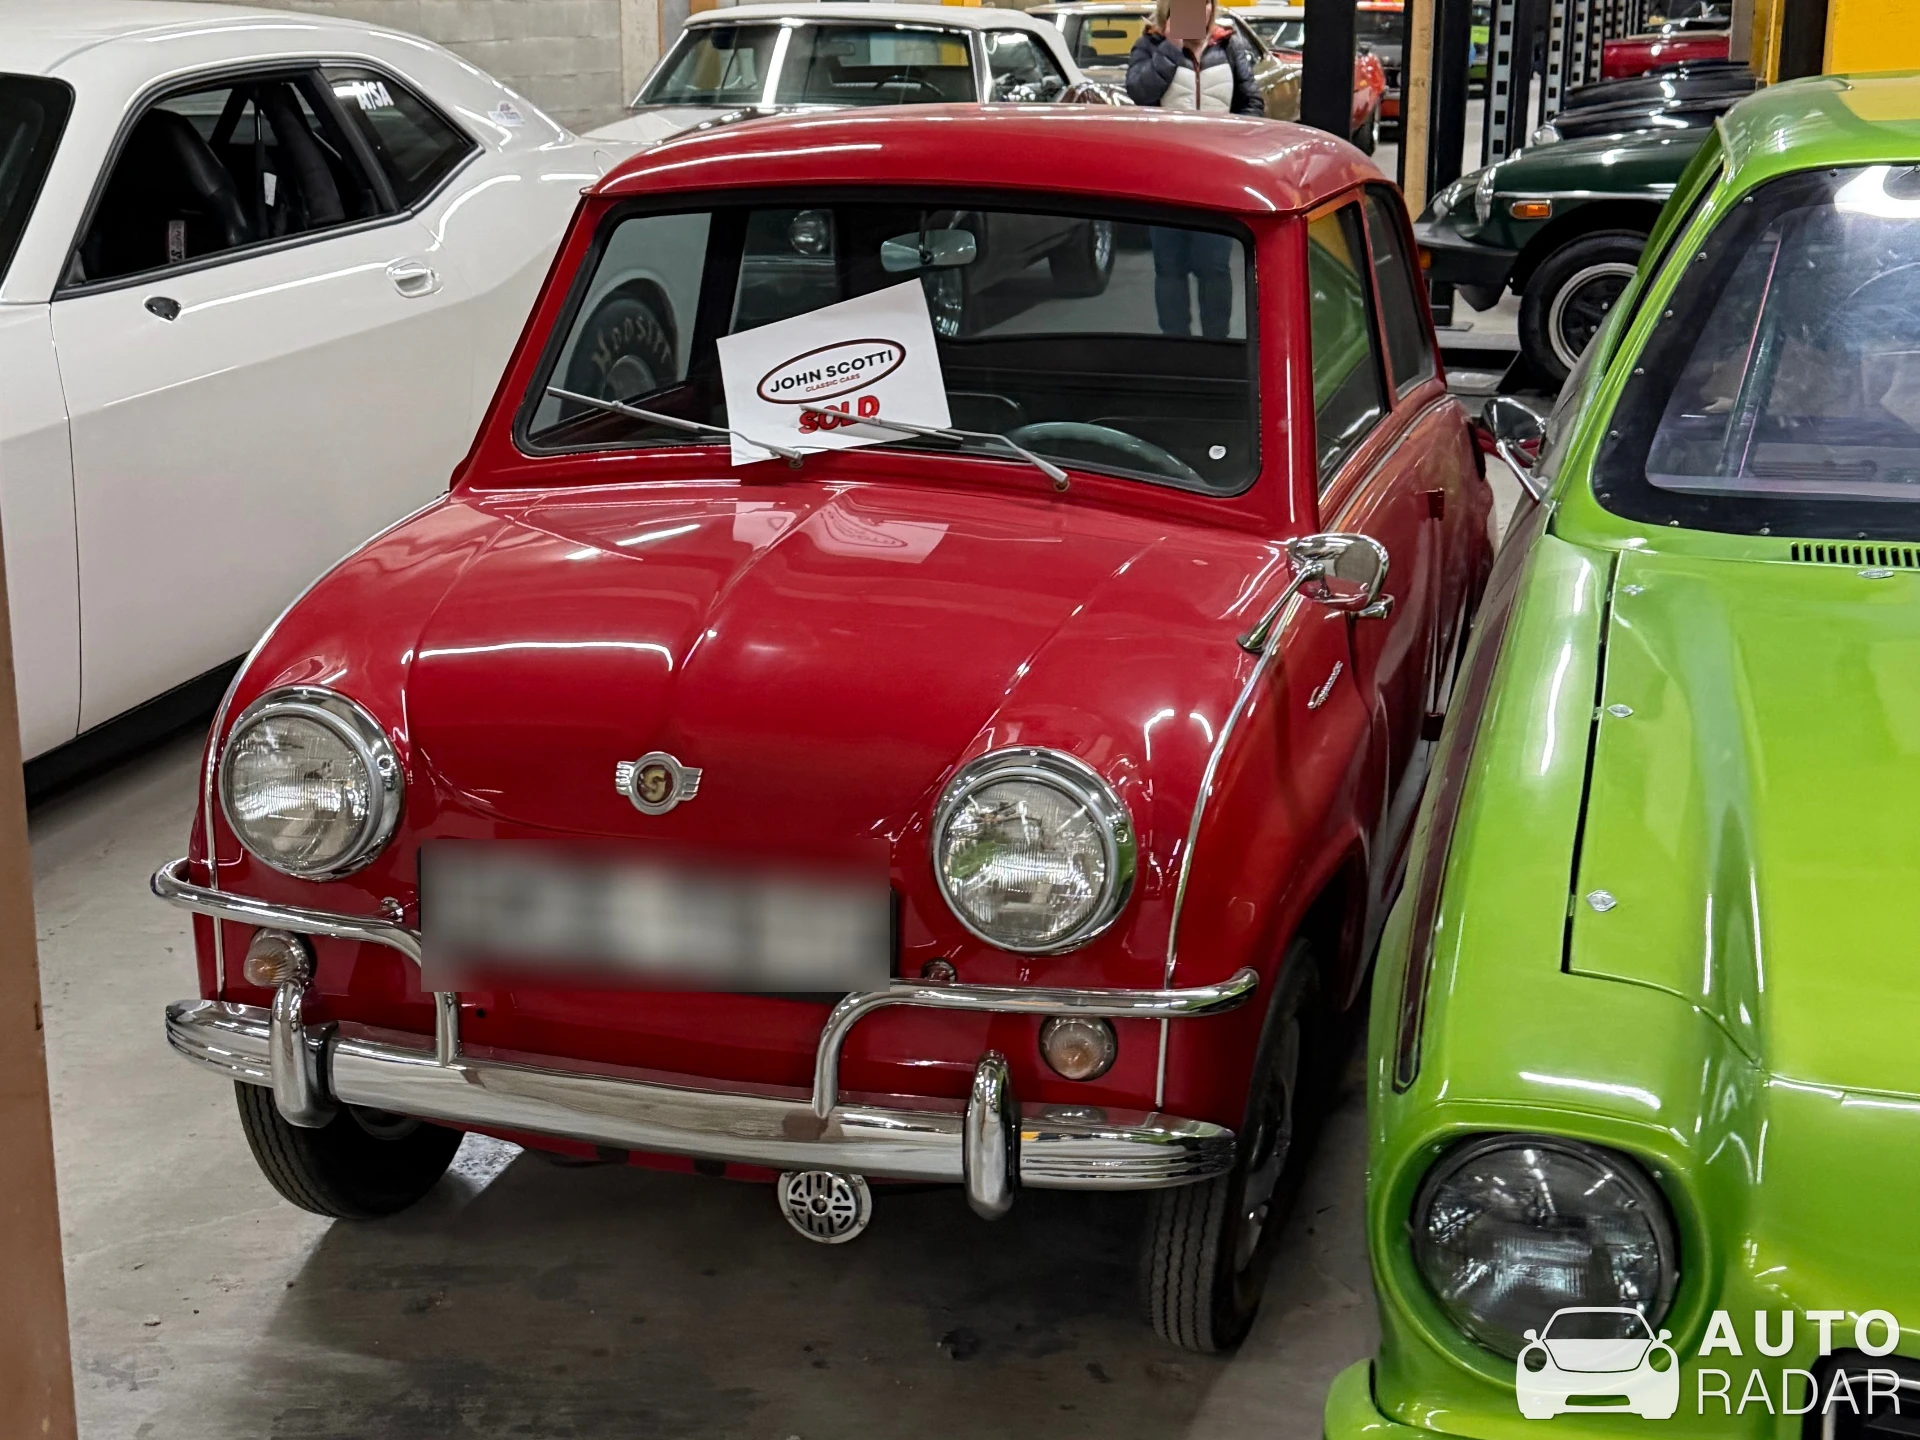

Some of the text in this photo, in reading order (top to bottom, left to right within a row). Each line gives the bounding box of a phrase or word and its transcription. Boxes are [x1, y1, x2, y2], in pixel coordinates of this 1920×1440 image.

[770, 350, 893, 393] JOHN SCOTTI
[805, 373, 861, 393] CLASSIC CARS
[798, 395, 880, 434] SOLD
